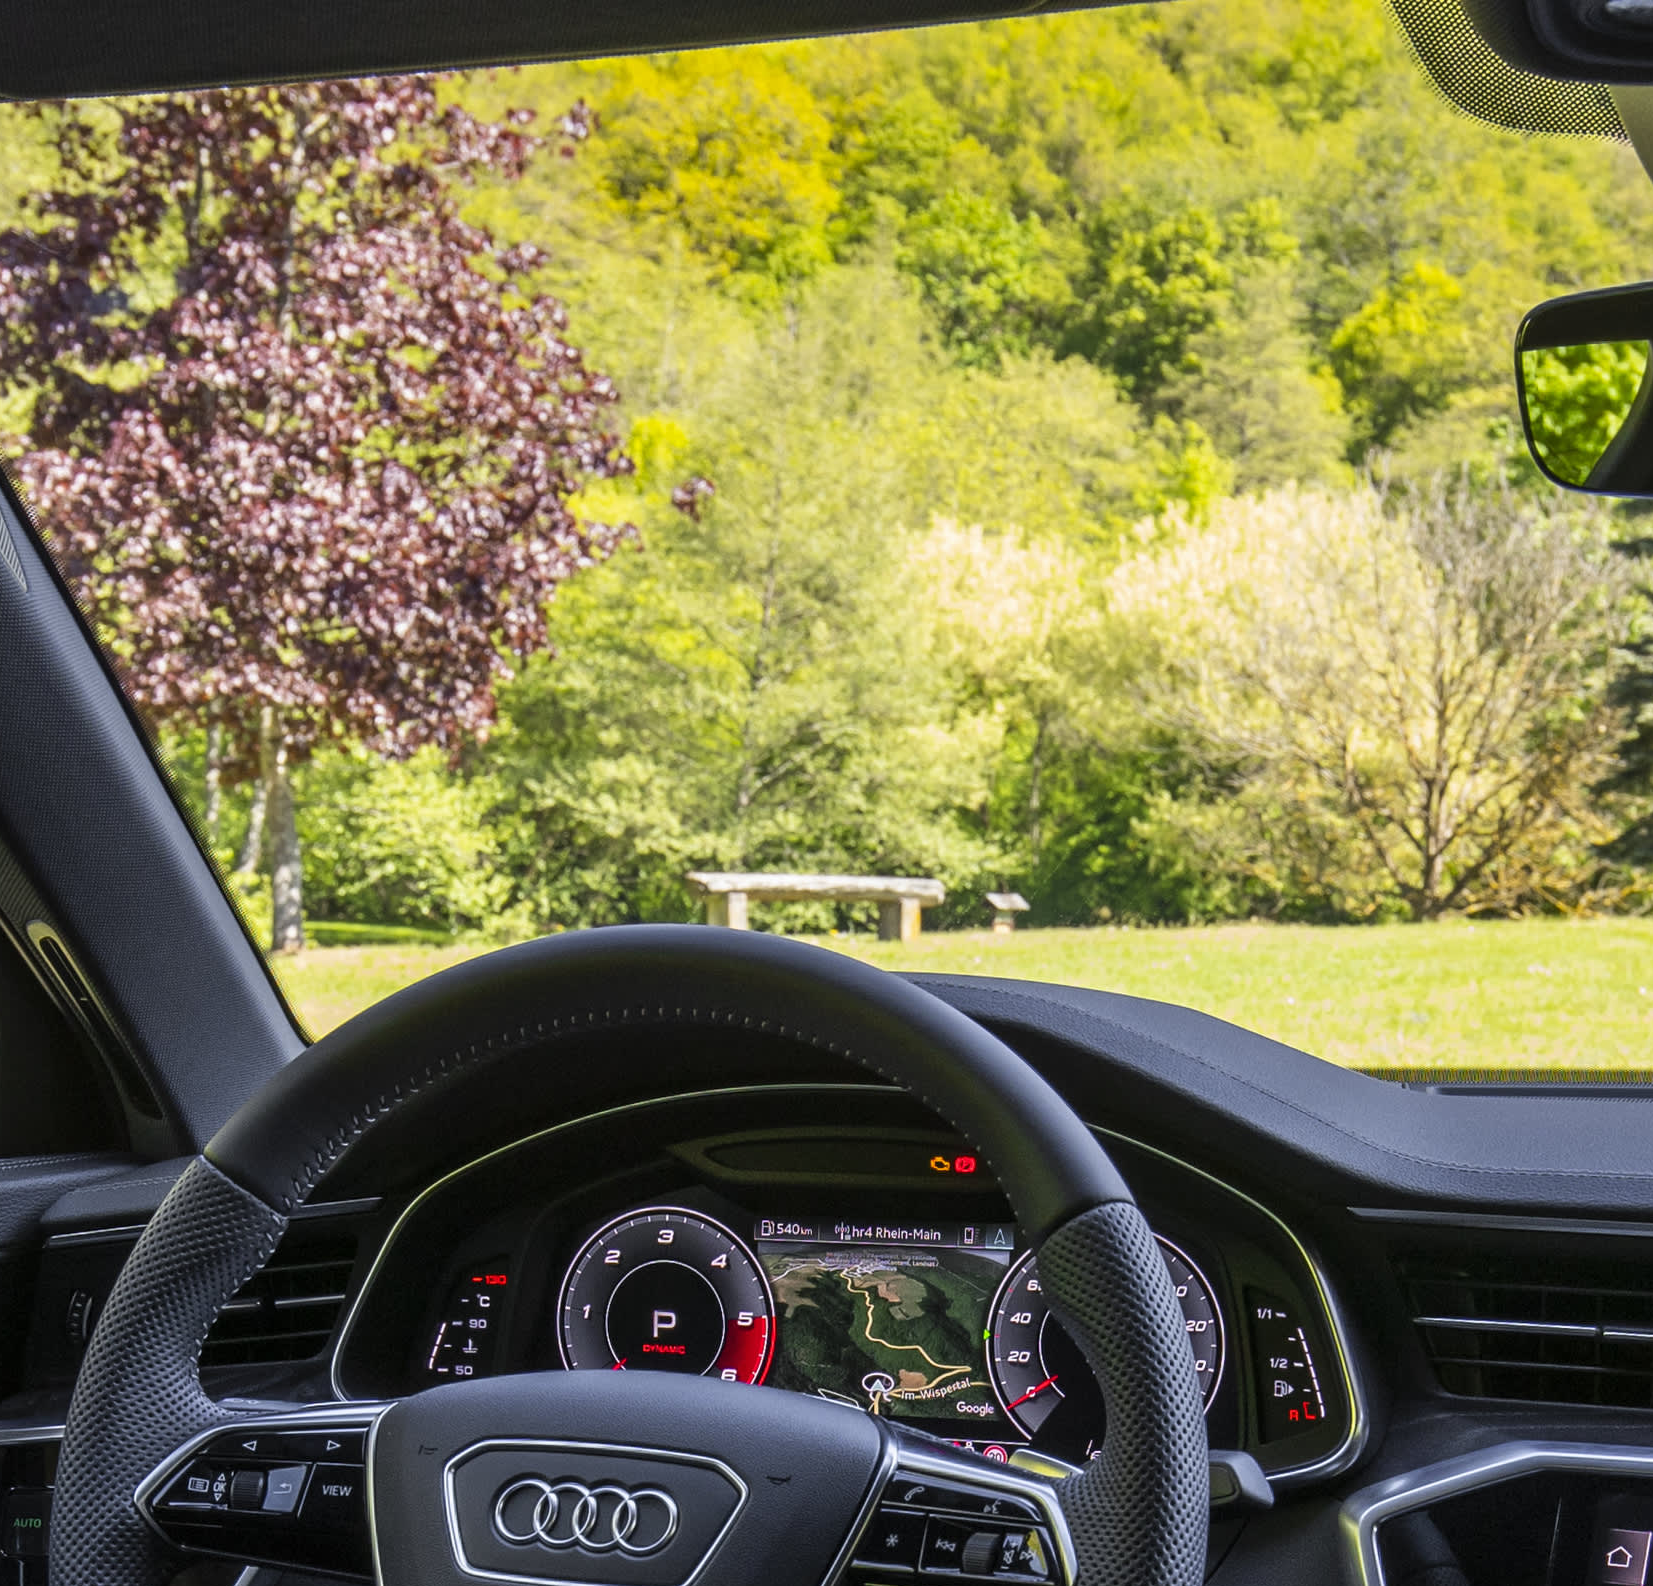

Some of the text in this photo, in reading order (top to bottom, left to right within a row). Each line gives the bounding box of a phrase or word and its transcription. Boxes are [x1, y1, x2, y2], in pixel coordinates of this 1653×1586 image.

[657, 1229, 675, 1244] 3
[852, 1225, 941, 1241] hr4 Rhein-Main
[604, 1250, 621, 1265] 2
[711, 1253, 728, 1269] 4
[485, 1274, 507, 1286] 130
[476, 1293, 491, 1308] °C
[582, 1304, 591, 1320] 1
[737, 1311, 754, 1327] 5
[1010, 1311, 1032, 1326] 40
[1256, 1307, 1272, 1320] 1/1
[468, 1318, 487, 1330] 90
[652, 1309, 677, 1338] P
[642, 1343, 687, 1355] DYNAMIC
[1007, 1350, 1031, 1363] 20
[454, 1365, 473, 1376] 50
[1269, 1357, 1288, 1370] 1/2
[720, 1368, 738, 1383] 6
[900, 1377, 971, 1401] Im Wispertal
[956, 1400, 995, 1417] Google
[213, 1481, 227, 1493] OK
[322, 1484, 353, 1497] VIEW
[12, 1517, 42, 1528] AUTO
